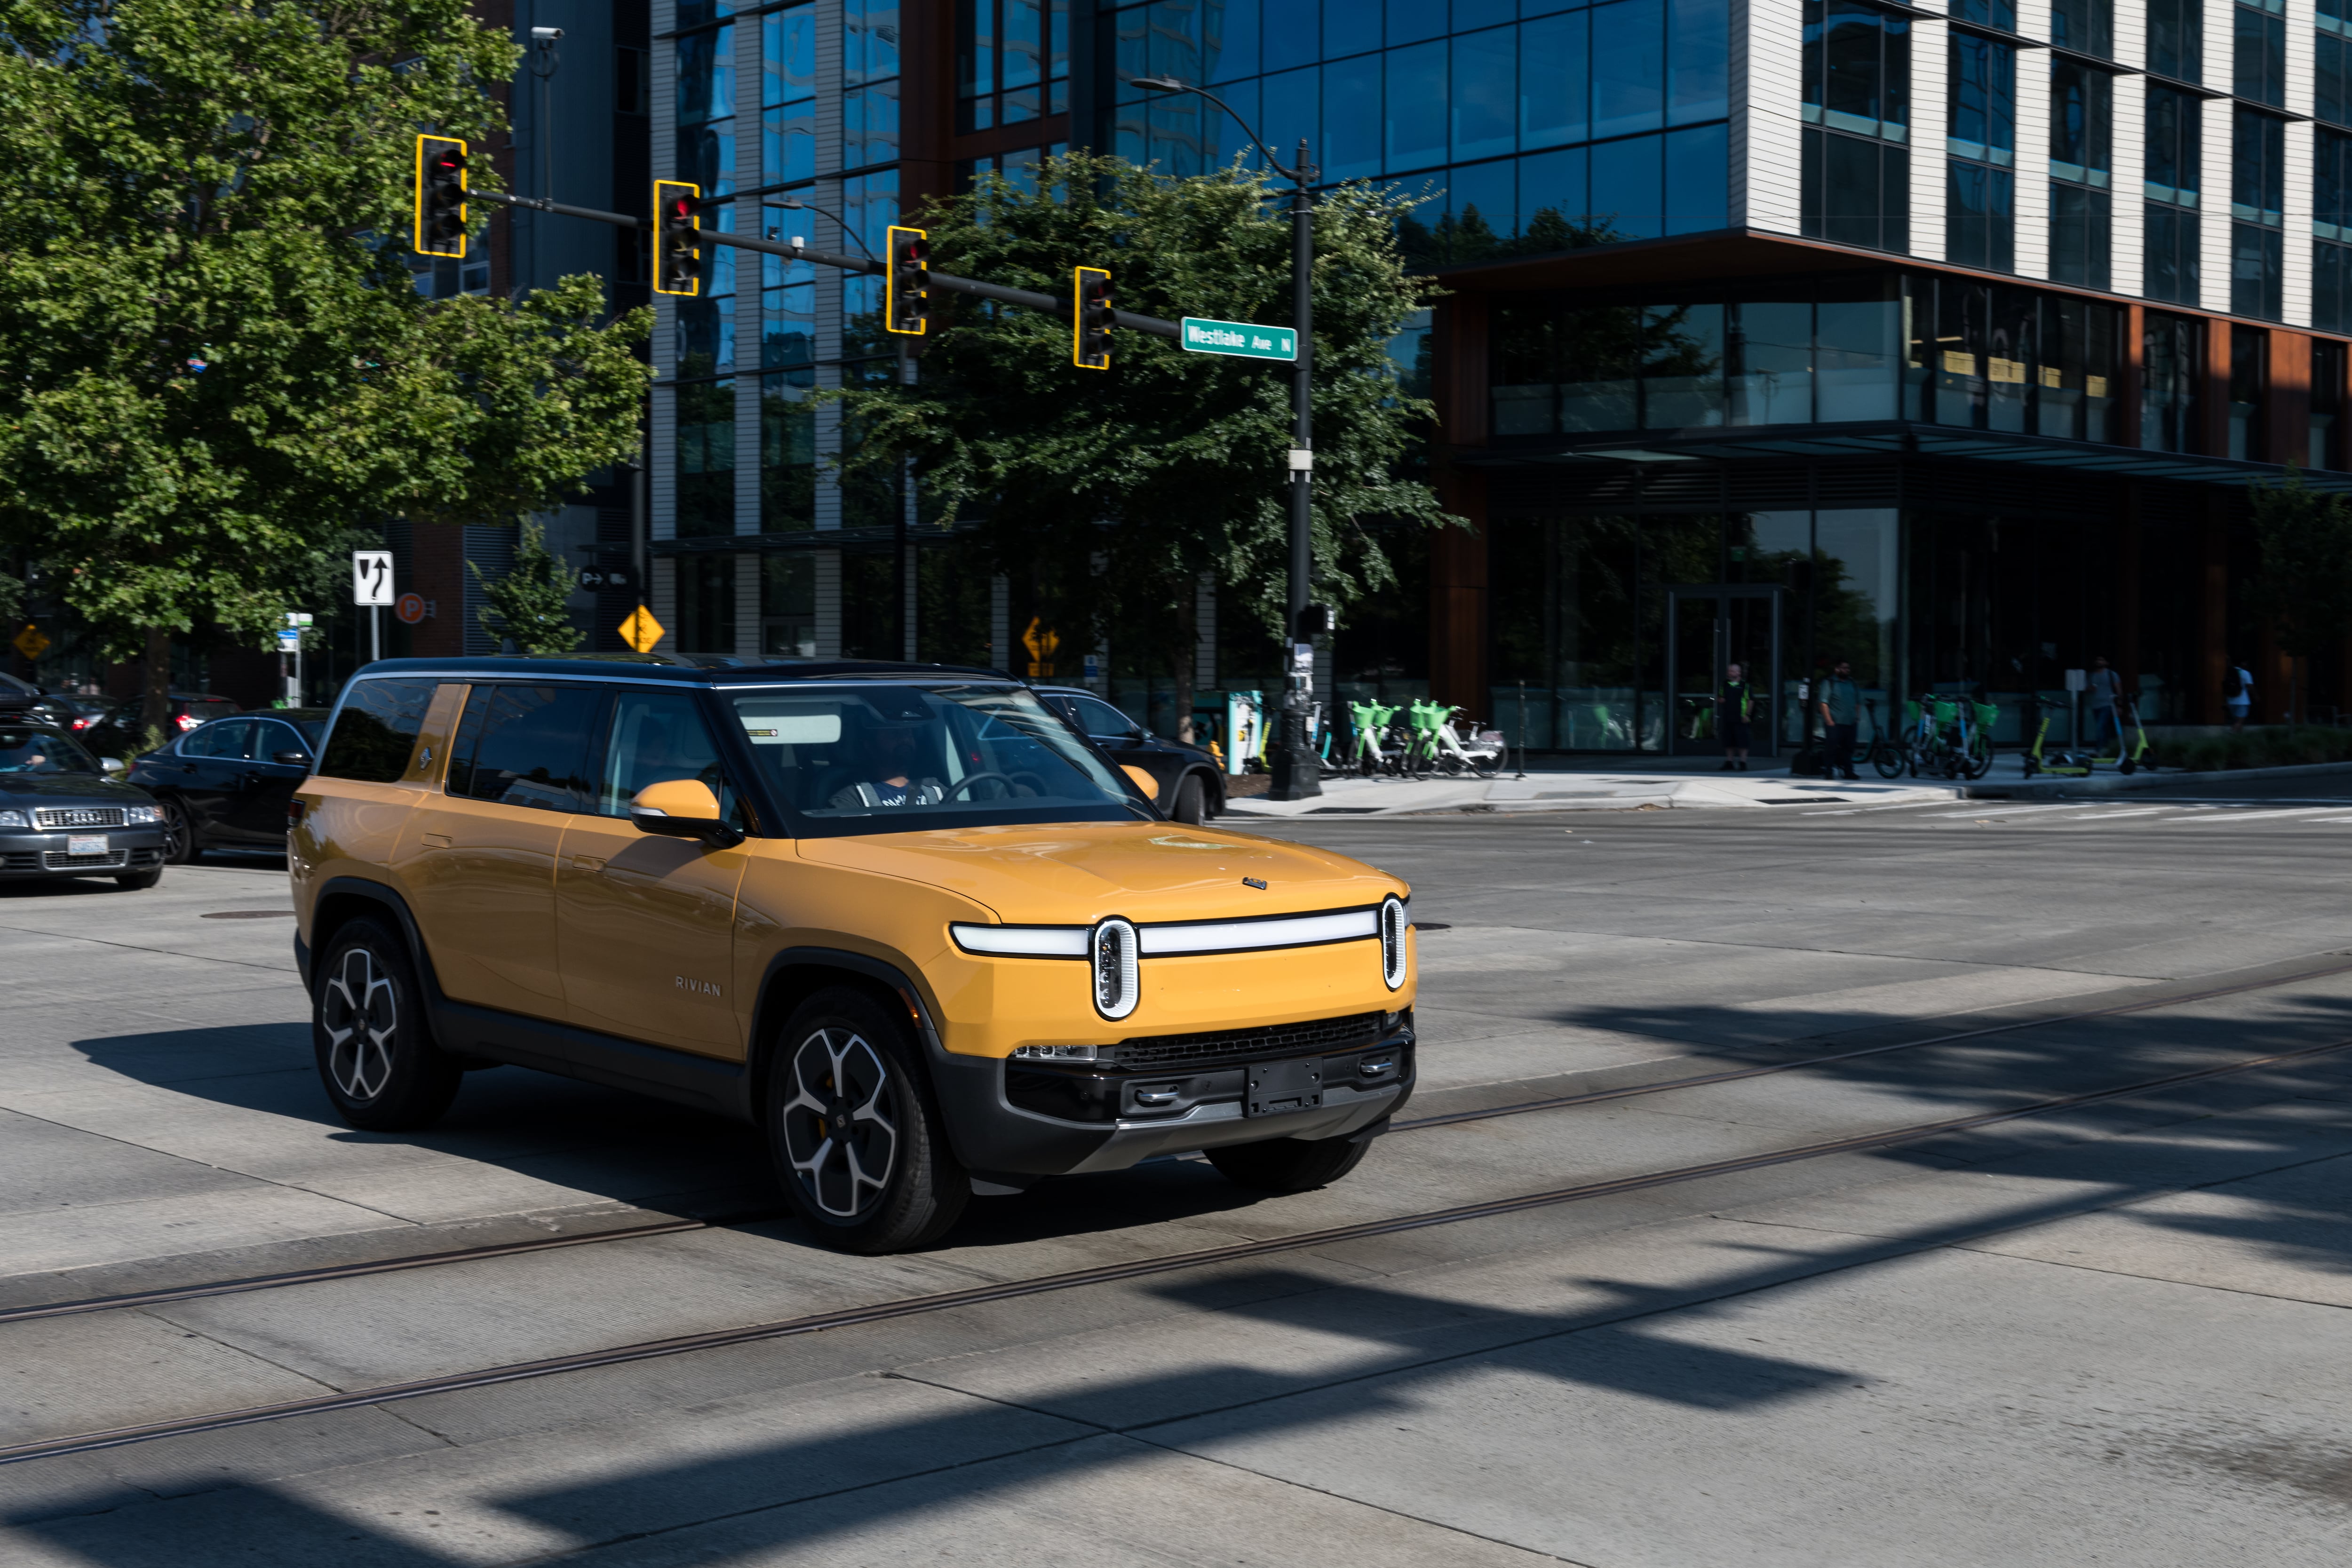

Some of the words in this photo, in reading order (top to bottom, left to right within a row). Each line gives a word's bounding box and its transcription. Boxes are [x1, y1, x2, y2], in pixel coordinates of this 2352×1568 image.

[1187, 325, 1245, 348] Westlake
[1251, 335, 1272, 350] Ave
[1281, 338, 1291, 352] N
[582, 573, 593, 585] P
[405, 600, 419, 617] P
[675, 976, 721, 997] RIVIAN
